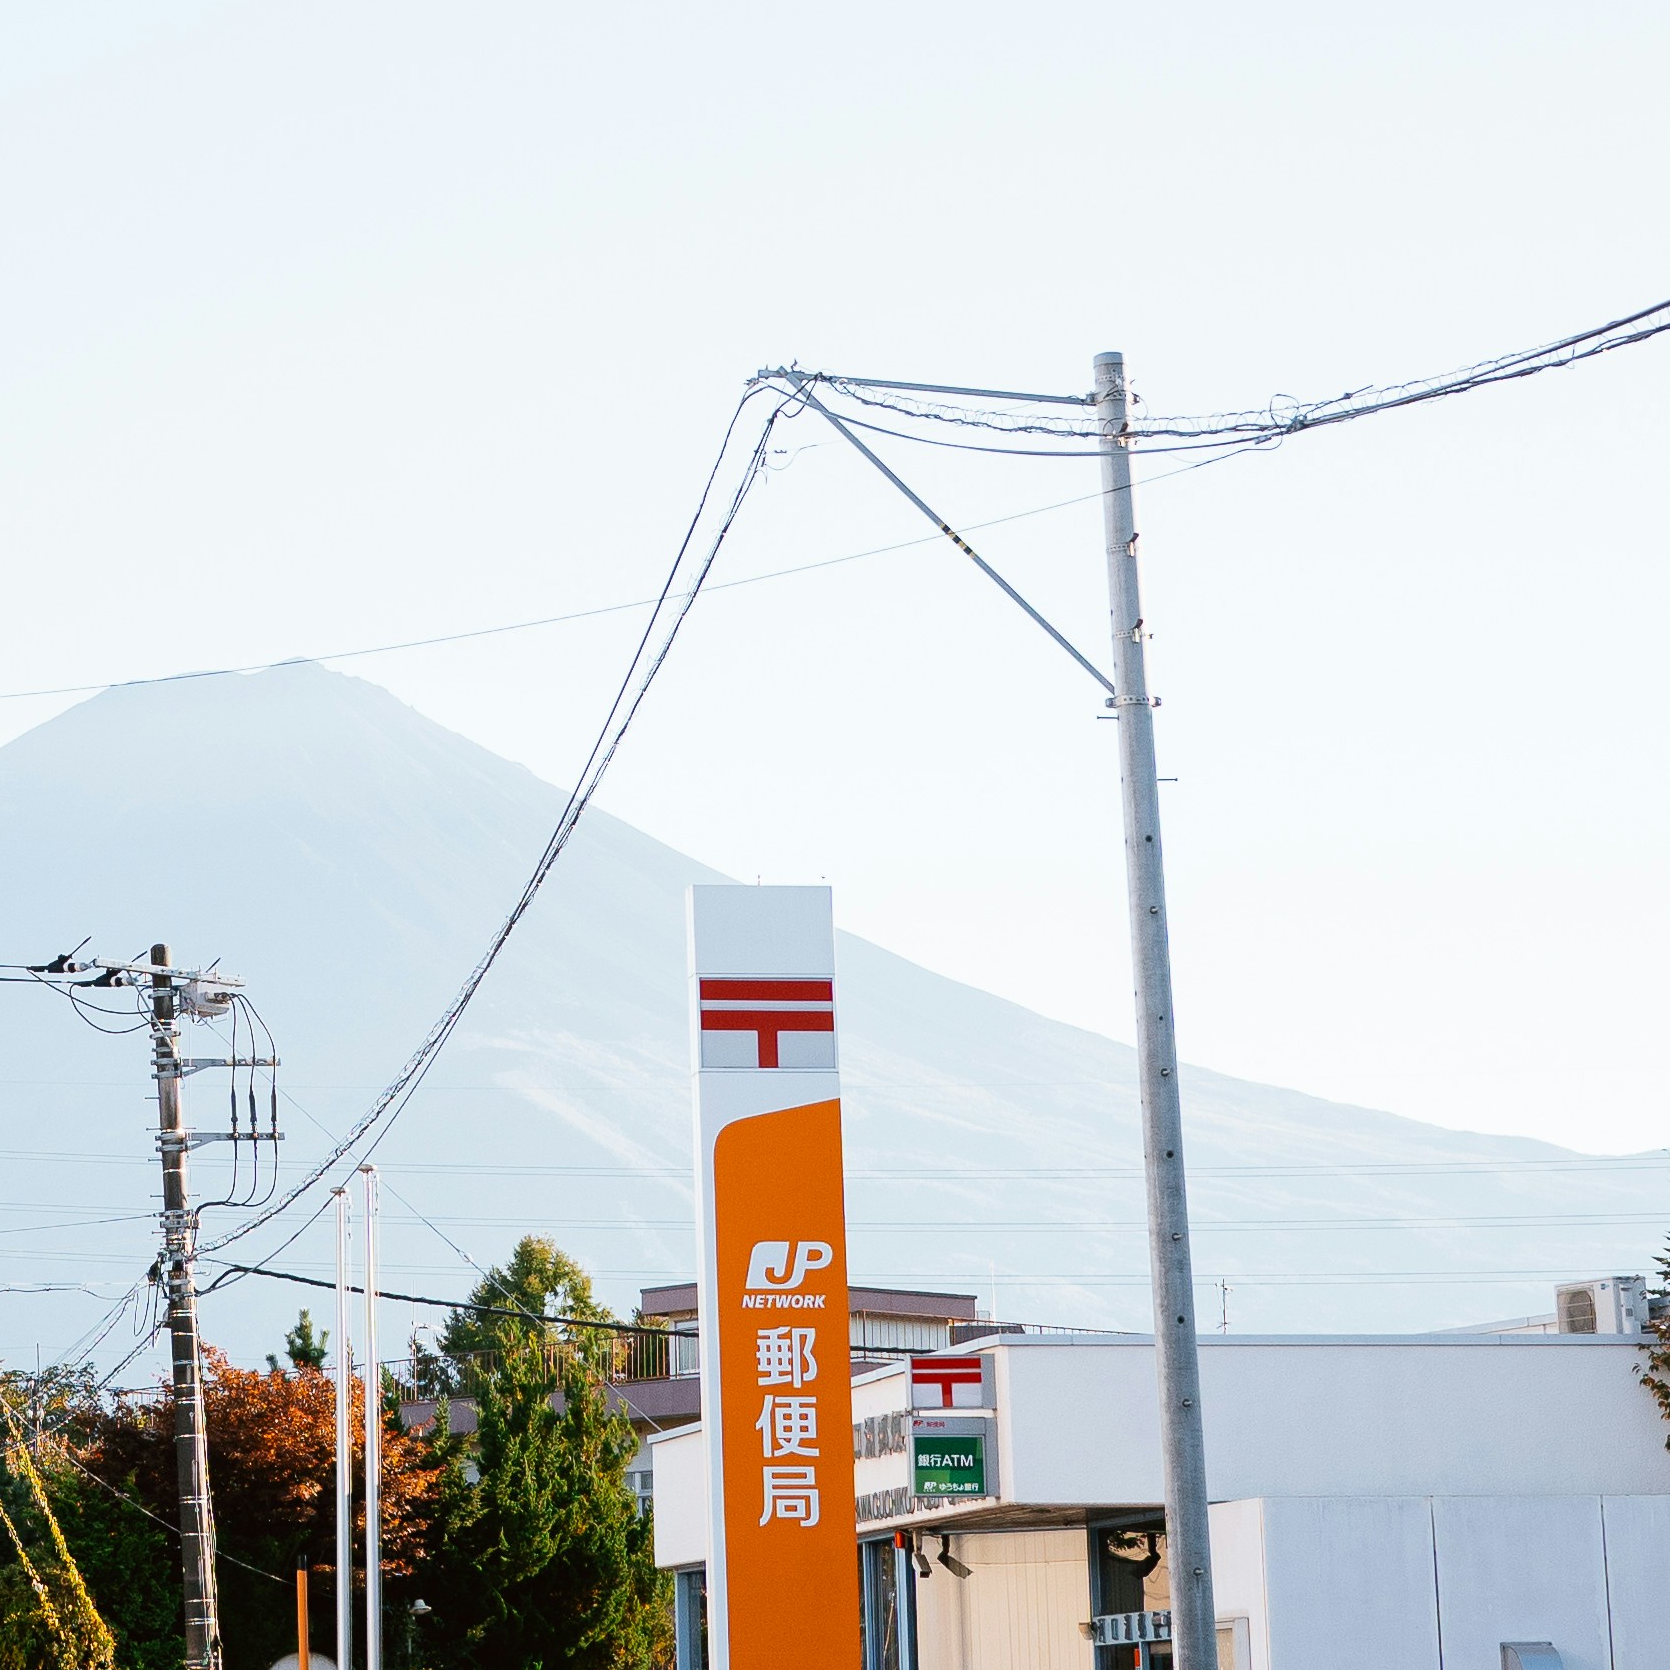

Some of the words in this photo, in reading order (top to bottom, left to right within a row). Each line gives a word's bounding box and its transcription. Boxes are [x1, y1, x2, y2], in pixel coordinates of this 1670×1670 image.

[742, 1294, 826, 1309] NETWORK
[755, 1326, 820, 1527] 郵便局
[917, 1454, 974, 1468] 銀行ATM
